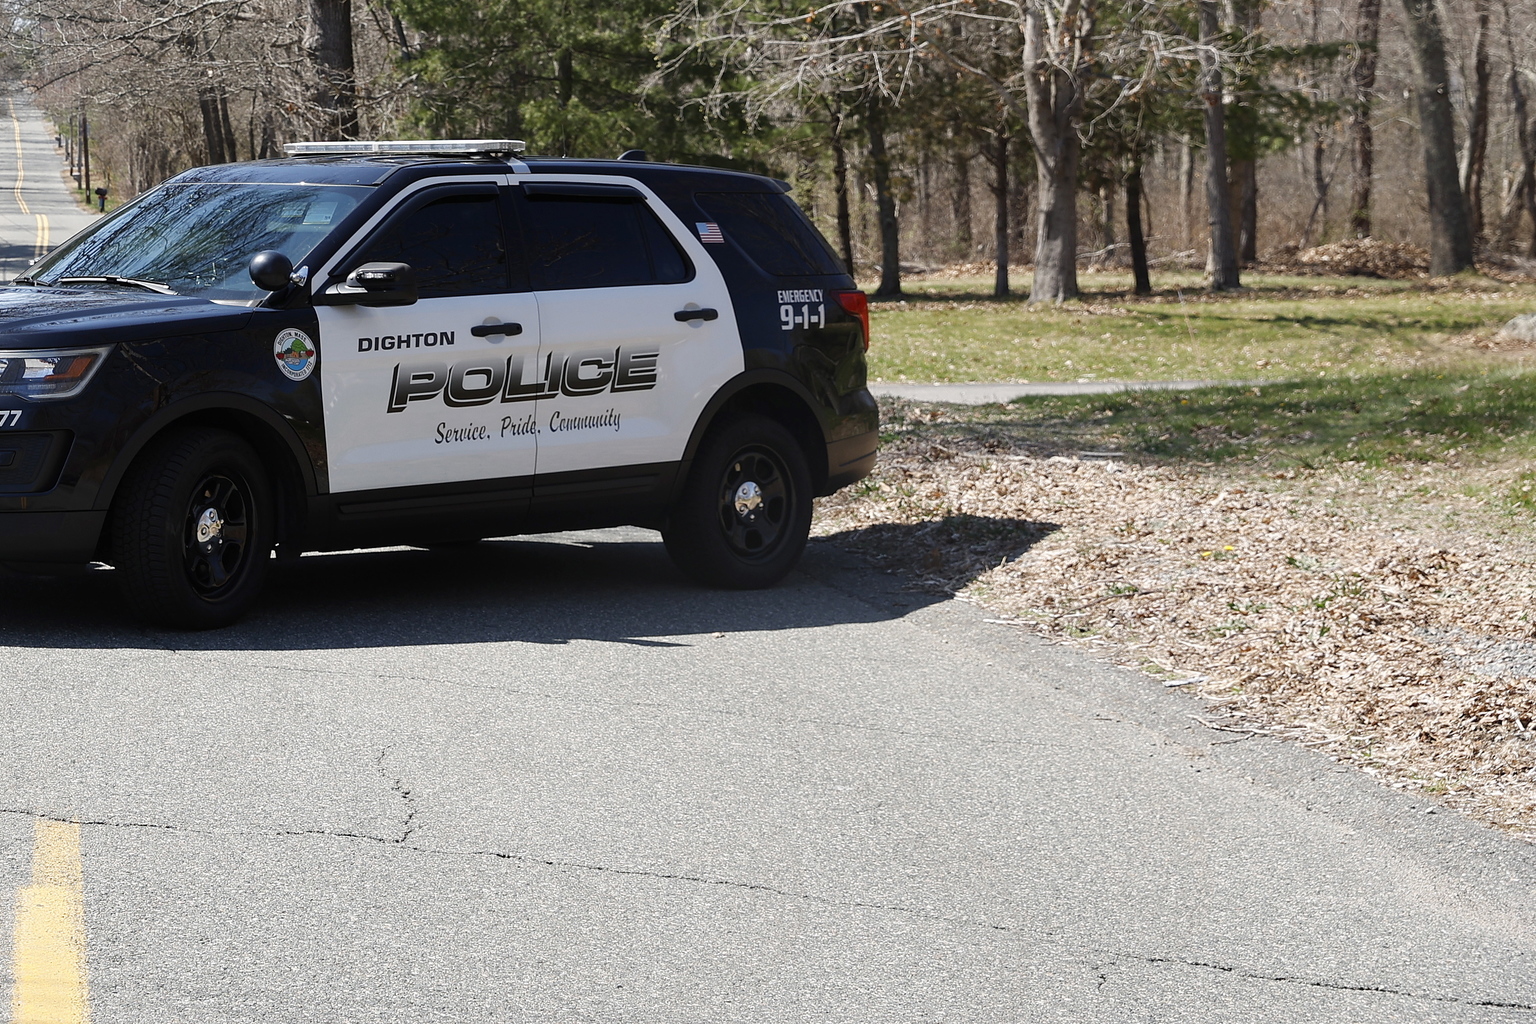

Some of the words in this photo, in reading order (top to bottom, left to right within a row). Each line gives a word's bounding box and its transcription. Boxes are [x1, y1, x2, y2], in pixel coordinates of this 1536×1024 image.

[777, 289, 823, 303] EMERGENCY
[780, 304, 825, 330] 9-1-1
[358, 331, 455, 352] DIGHTON
[386, 345, 660, 413] POLICE
[549, 408, 621, 432] Community
